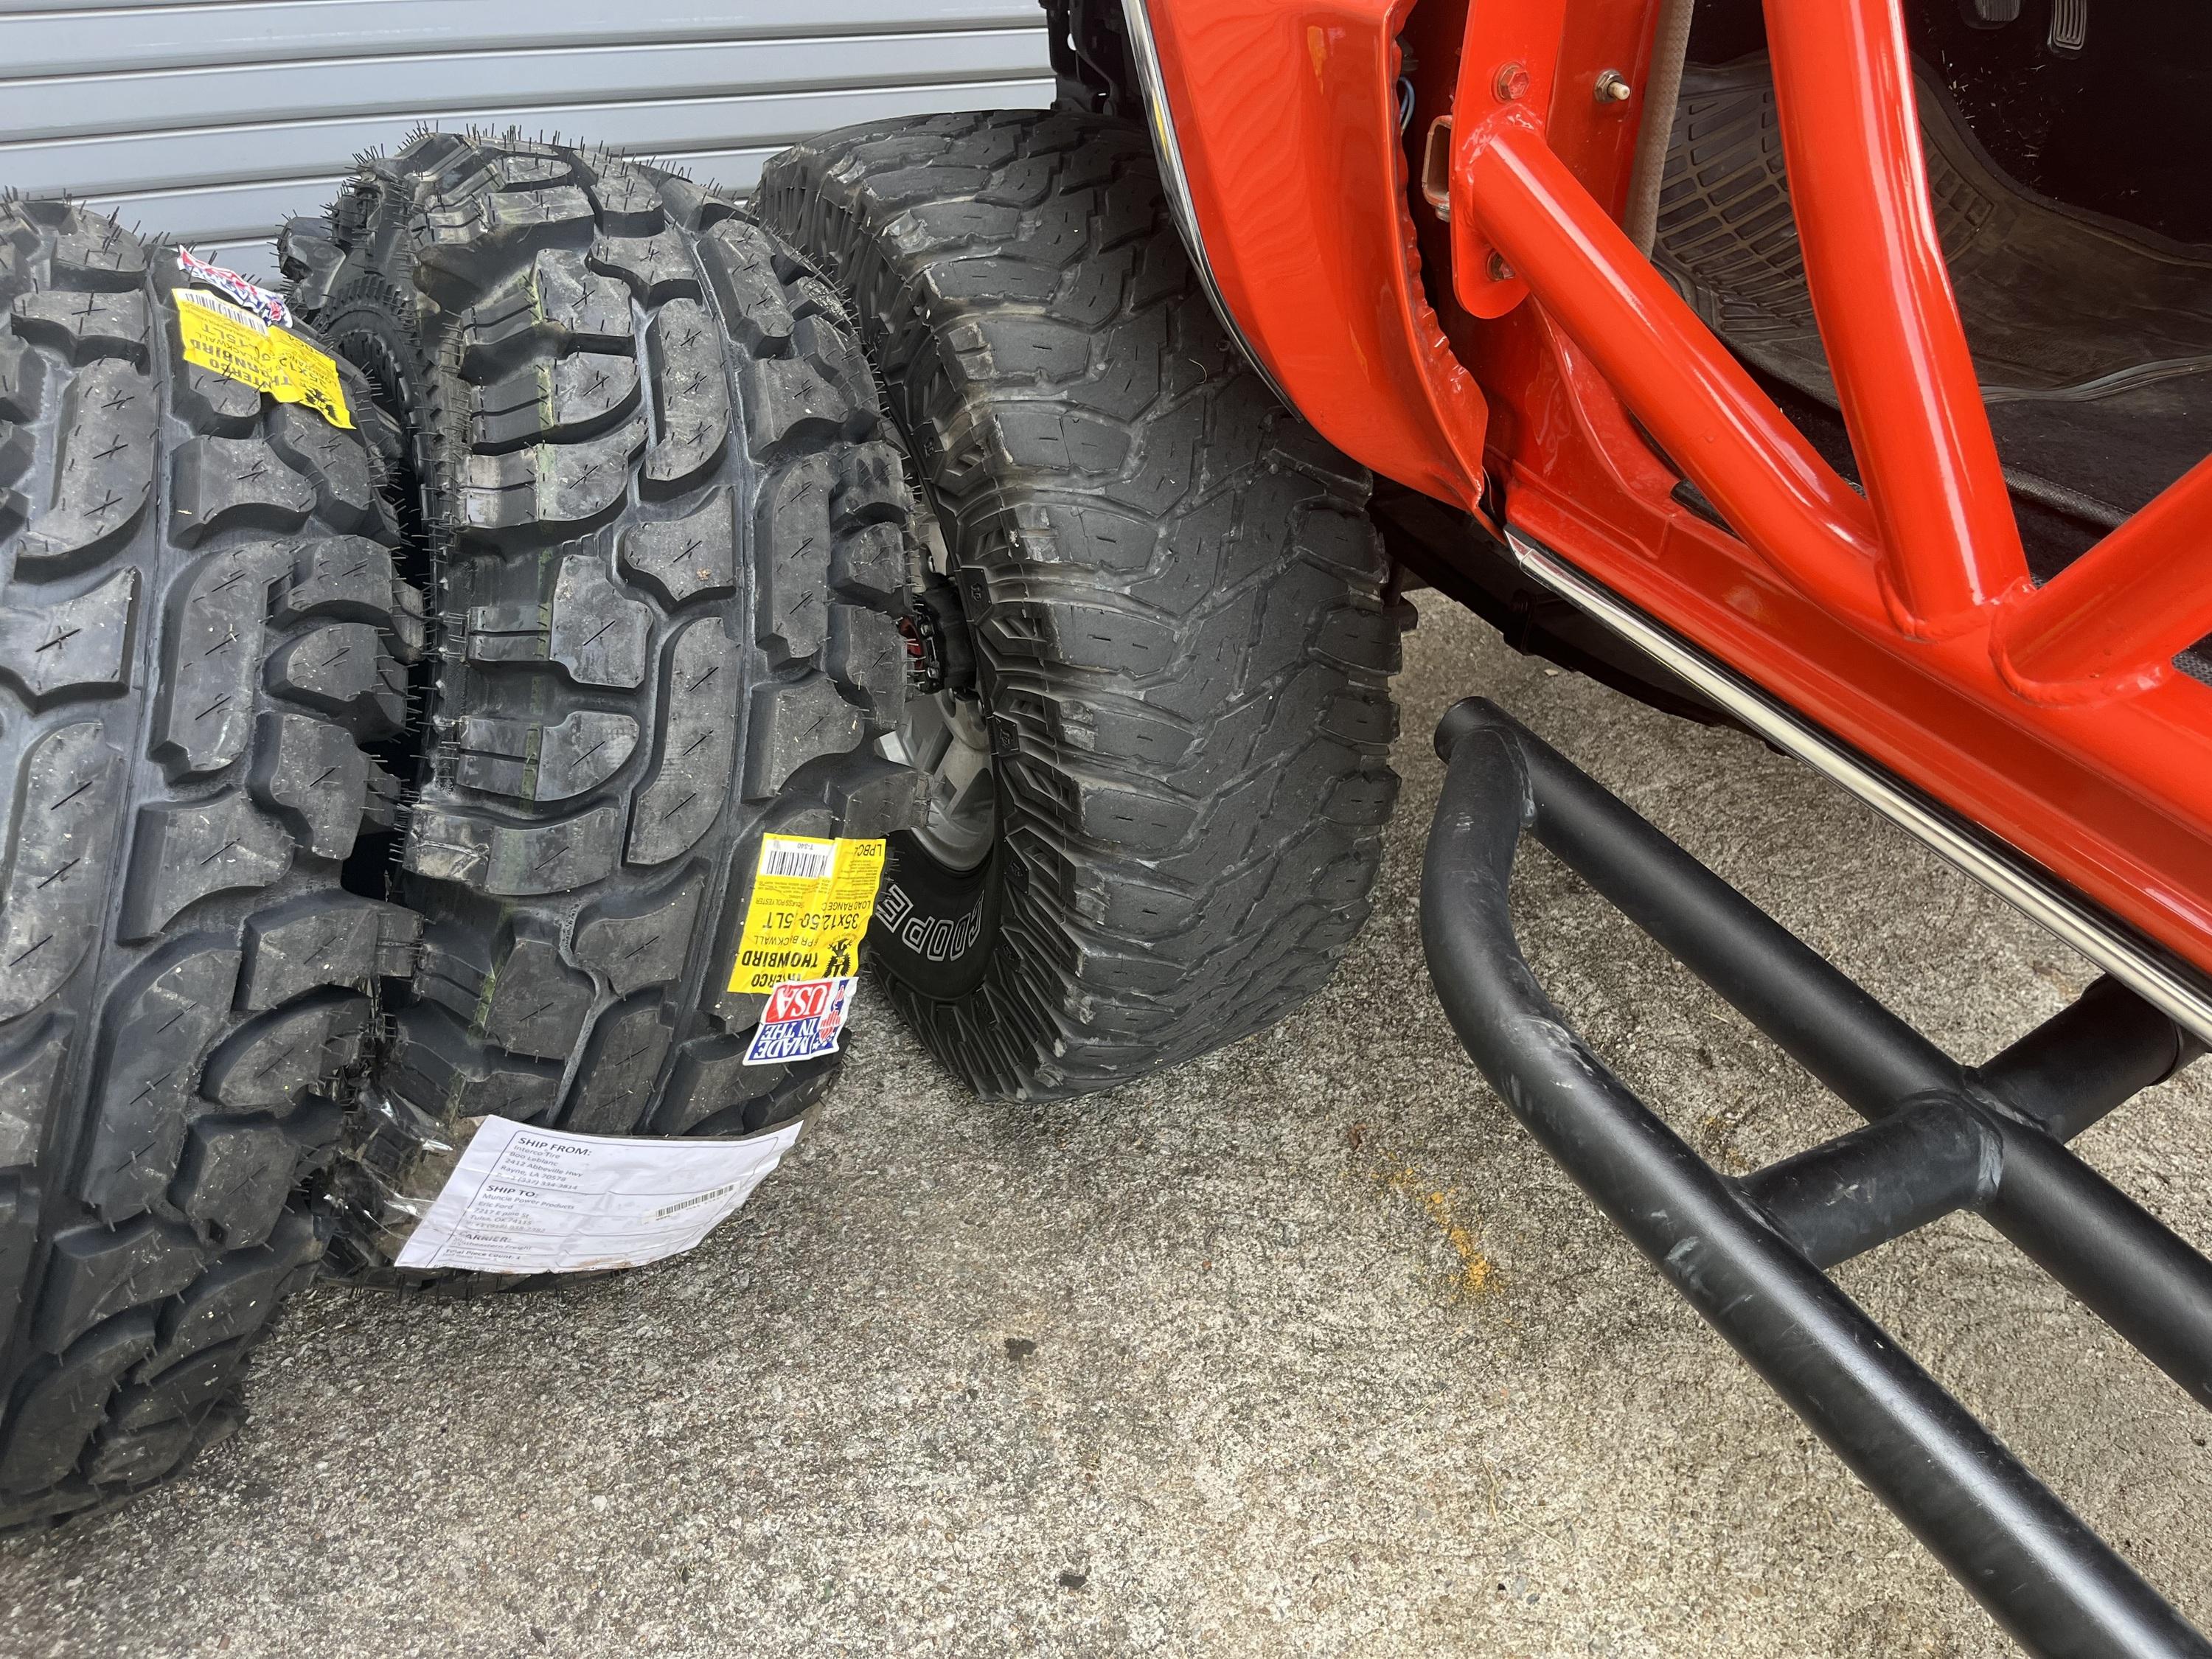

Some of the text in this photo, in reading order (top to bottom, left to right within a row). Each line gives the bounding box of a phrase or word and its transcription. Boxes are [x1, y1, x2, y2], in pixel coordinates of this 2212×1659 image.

[829, 902, 854, 911] RANGE
[853, 900, 872, 911] LOAD
[875, 884, 985, 961] COOPE
[776, 985, 827, 1017] USA
[760, 1018, 818, 1040] IN THE
[753, 1036, 811, 1060] MADE
[514, 1145, 560, 1159] Interco Tire
[518, 1137, 592, 1156] SHIP FROM:
[501, 1165, 526, 1177] Rayne,
[541, 1173, 567, 1182] 70578
[505, 1158, 583, 1178] 2412 Abbeville Hwy
[486, 1184, 539, 1198] SHIP TO:
[481, 1193, 575, 1210] Muncie Power Products
